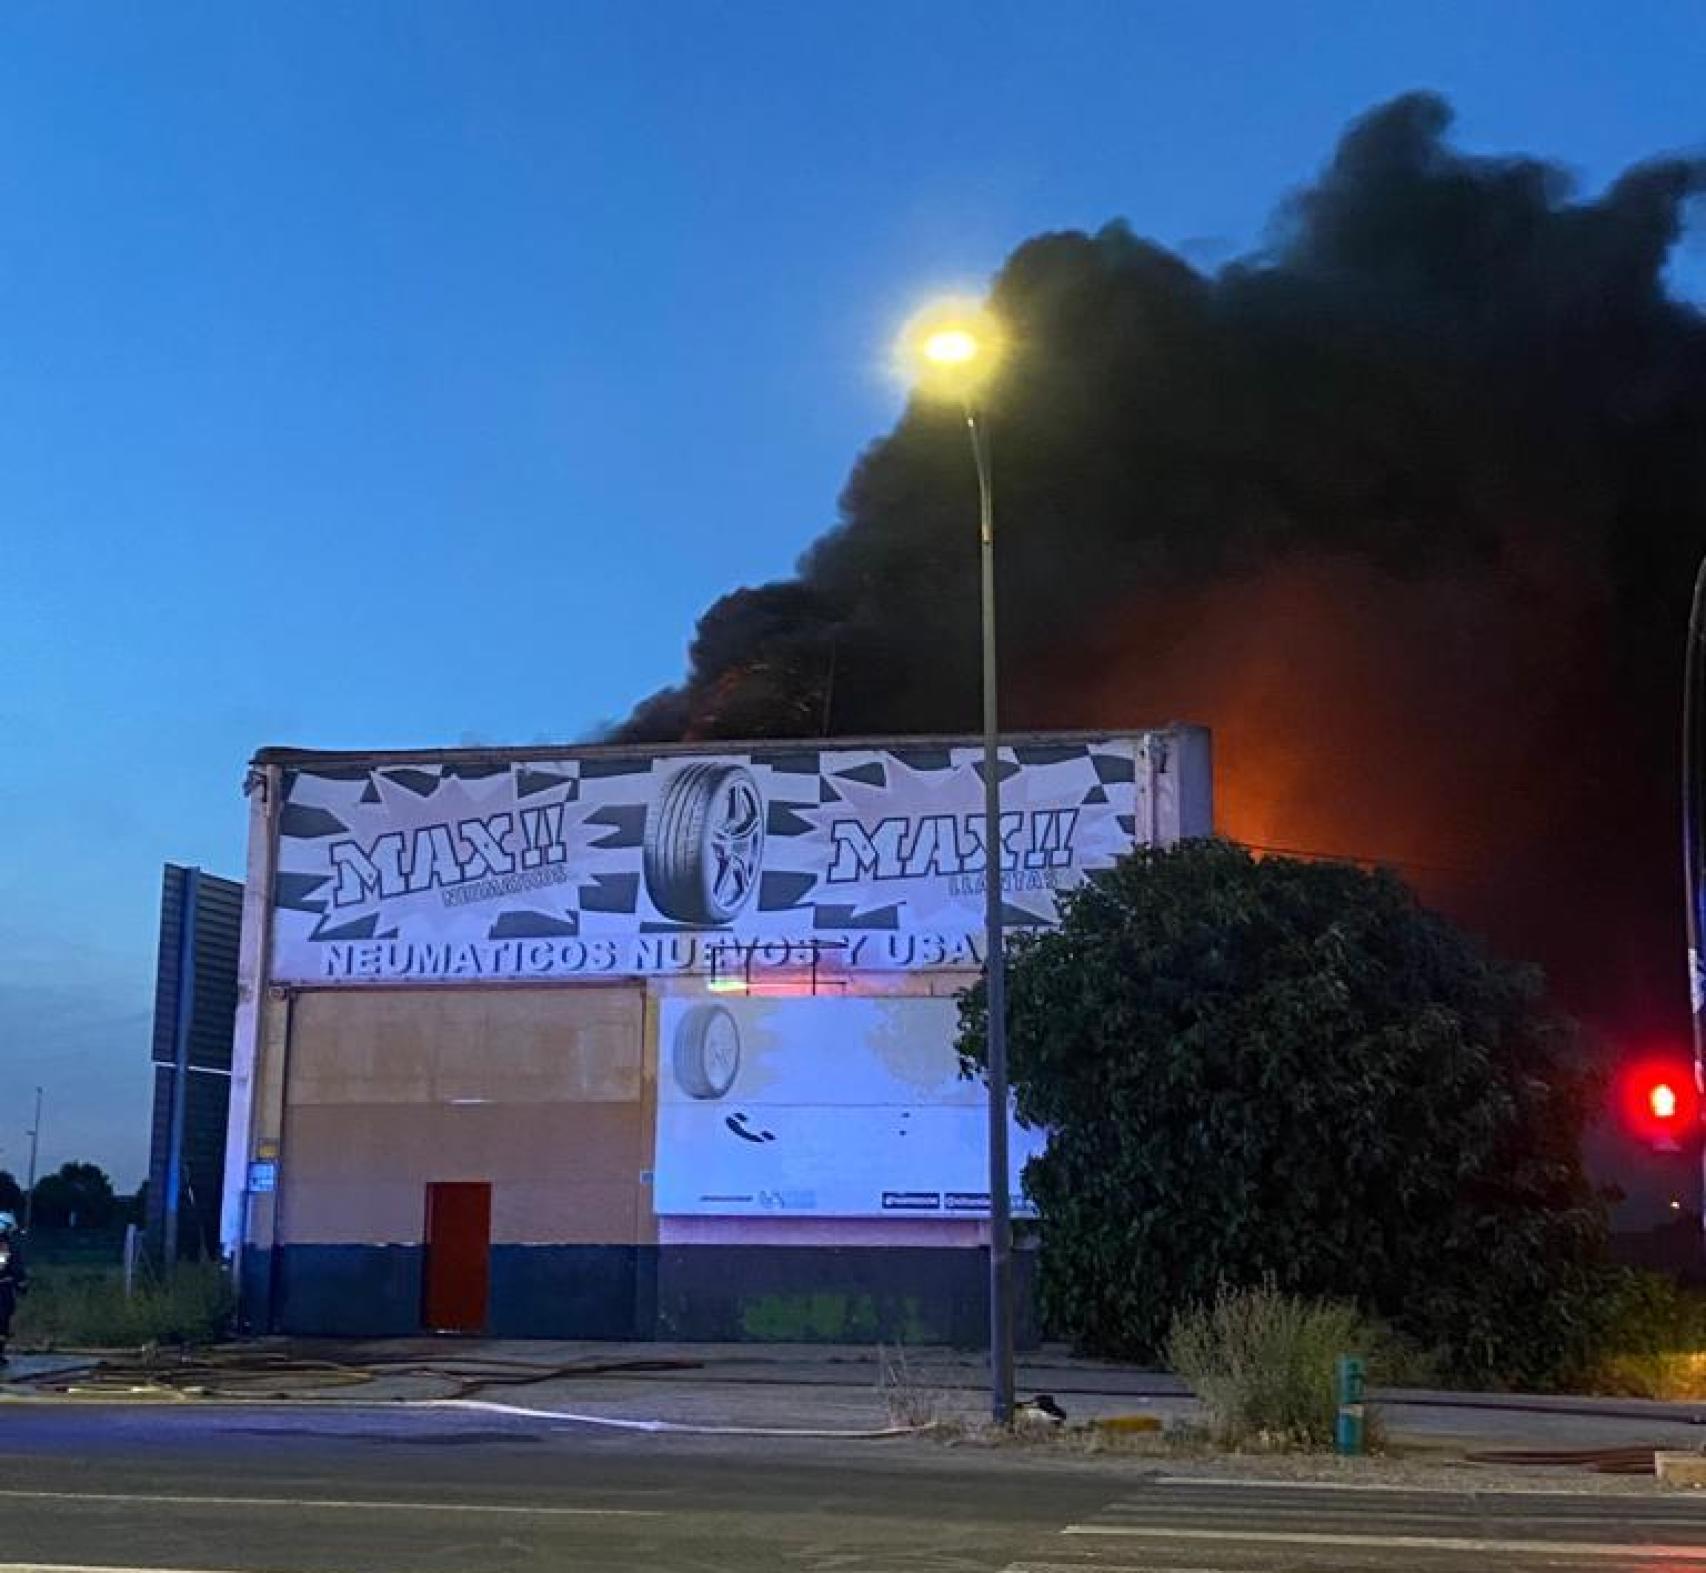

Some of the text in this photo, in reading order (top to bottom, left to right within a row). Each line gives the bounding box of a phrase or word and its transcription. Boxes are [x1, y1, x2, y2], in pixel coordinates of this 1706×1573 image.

[330, 803, 567, 907] MAX!!
[826, 809, 1080, 882] MAX!!
[322, 933, 985, 977] NEUMATICOS NUEVOS Y USA
